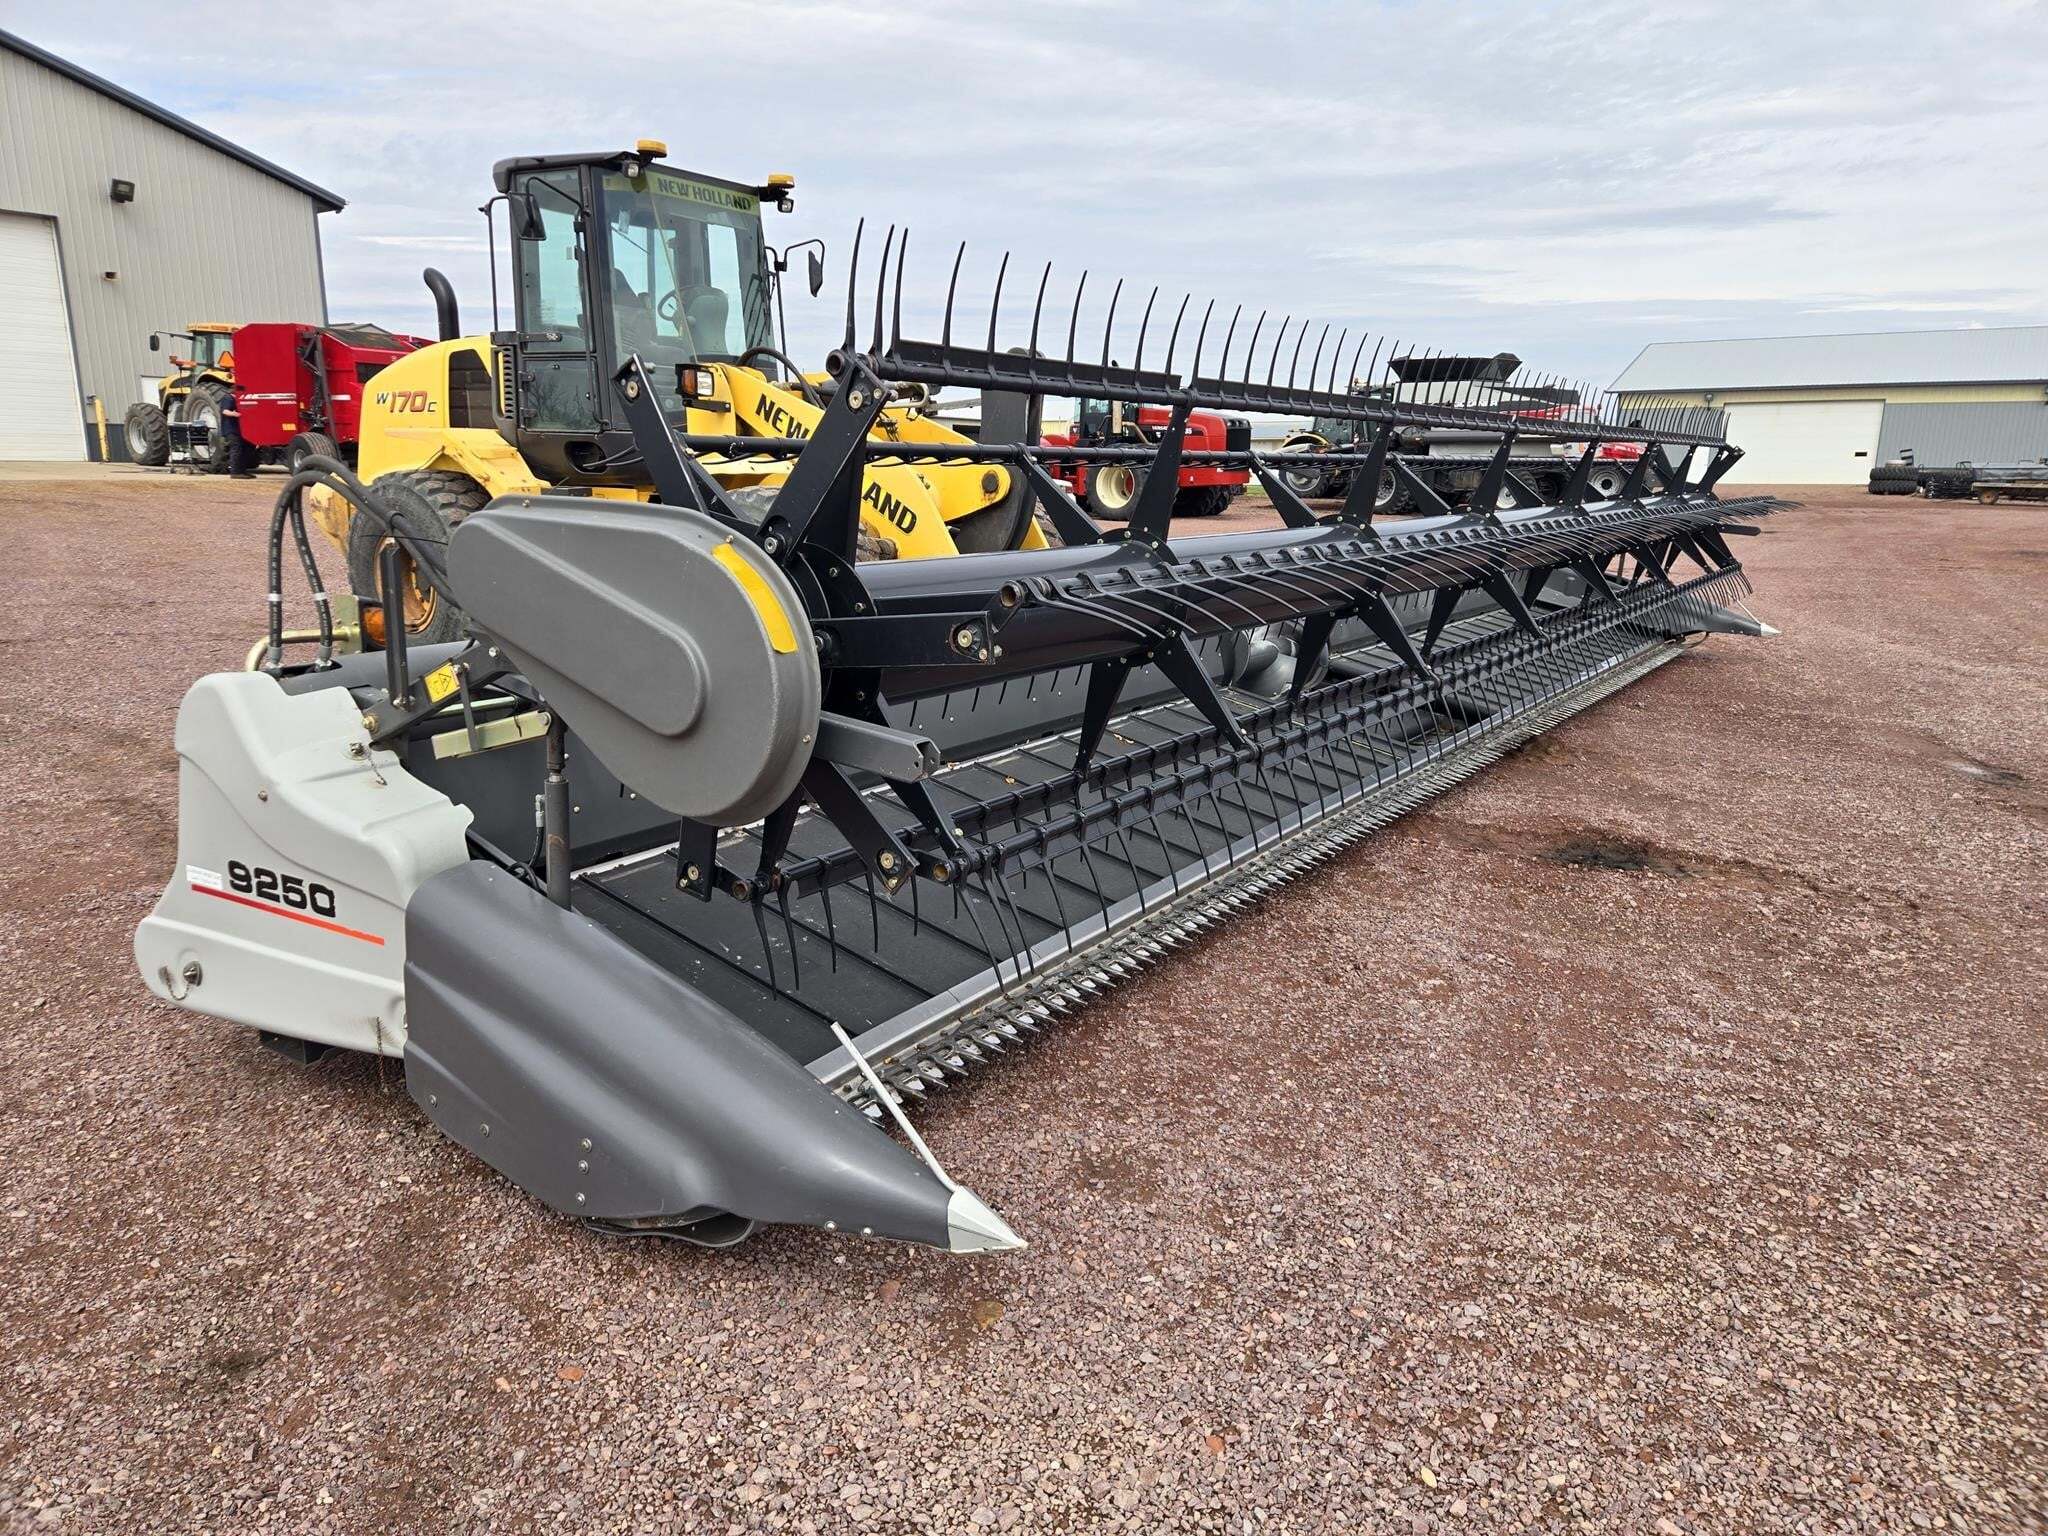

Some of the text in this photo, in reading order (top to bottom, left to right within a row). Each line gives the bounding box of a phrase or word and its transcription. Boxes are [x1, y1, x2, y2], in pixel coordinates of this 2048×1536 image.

[657, 178, 752, 210] NEW HOLLAND
[755, 392, 810, 439] NEW
[227, 859, 337, 918] 9250
